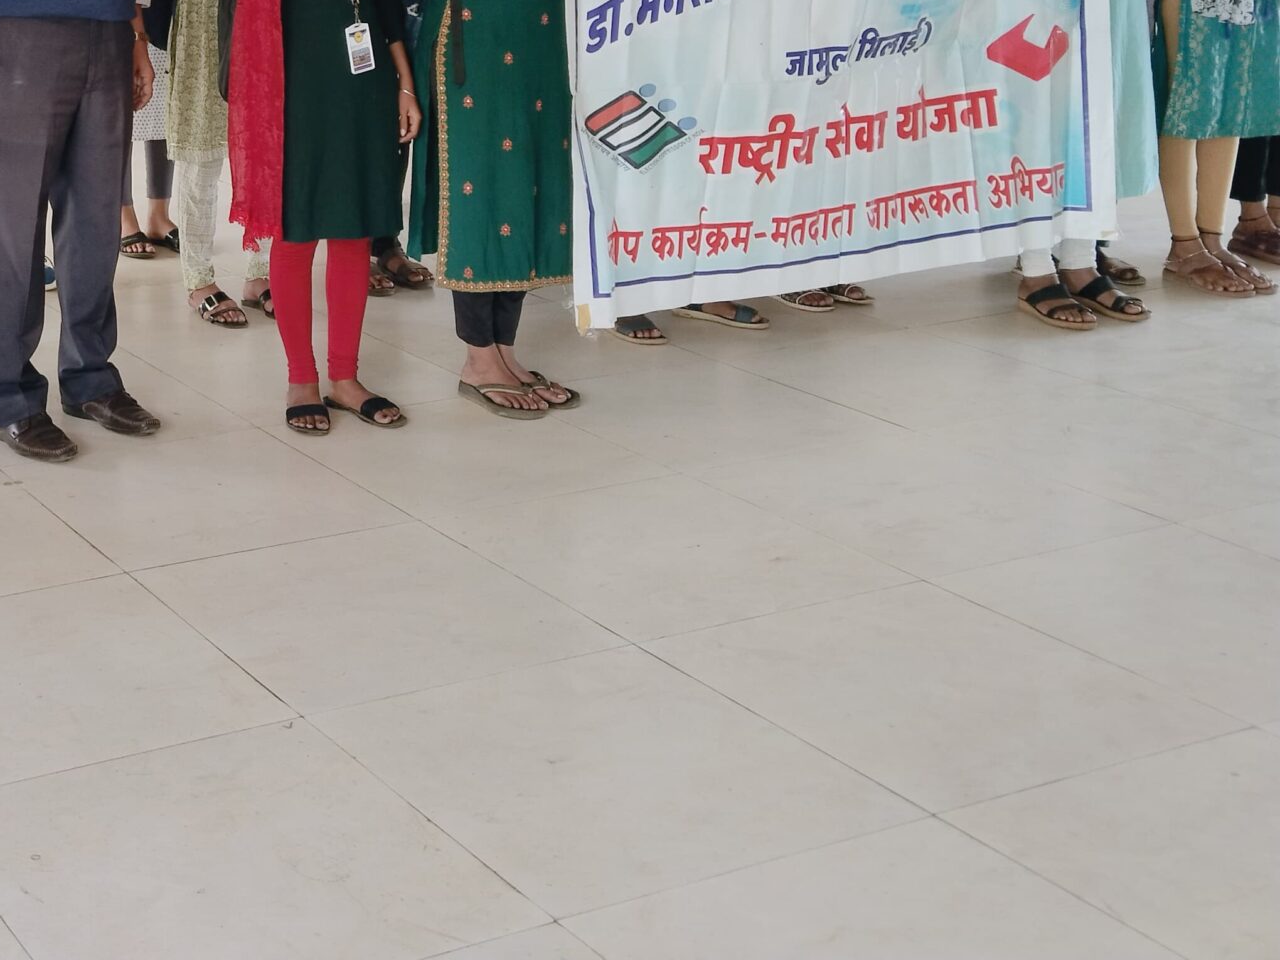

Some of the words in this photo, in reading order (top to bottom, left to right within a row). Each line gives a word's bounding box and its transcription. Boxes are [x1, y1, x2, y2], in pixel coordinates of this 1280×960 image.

[698, 113, 819, 185] राष्ट्रीय
[825, 102, 888, 159] सेवा
[896, 85, 998, 142] योजना
[866, 179, 980, 231] जागरूकता
